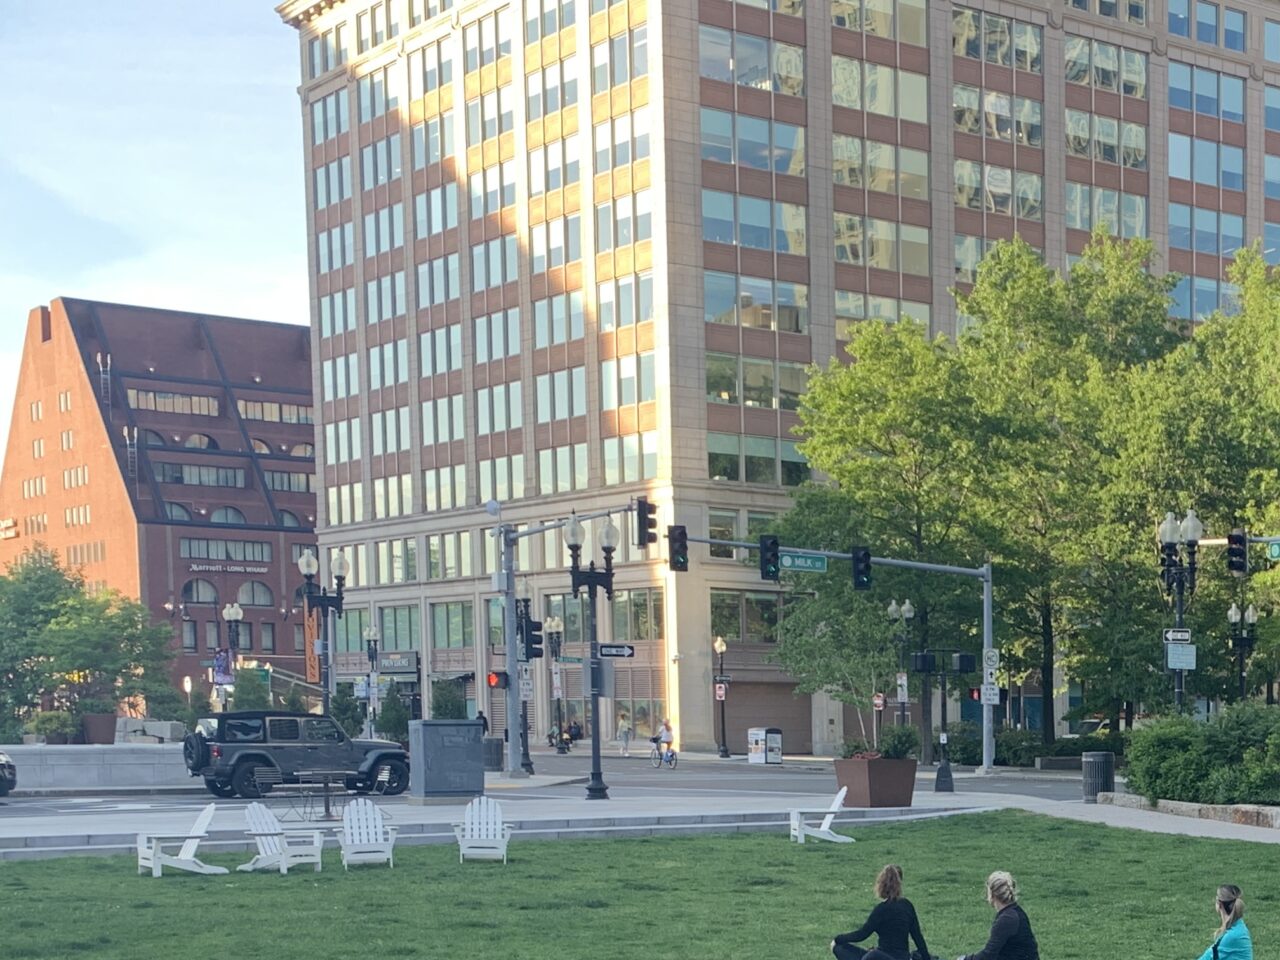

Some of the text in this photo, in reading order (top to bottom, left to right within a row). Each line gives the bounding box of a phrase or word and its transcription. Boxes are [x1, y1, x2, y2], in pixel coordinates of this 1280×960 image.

[794, 557, 815, 568] MILK
[189, 563, 222, 572] Marriott
[226, 565, 245, 573] LONG
